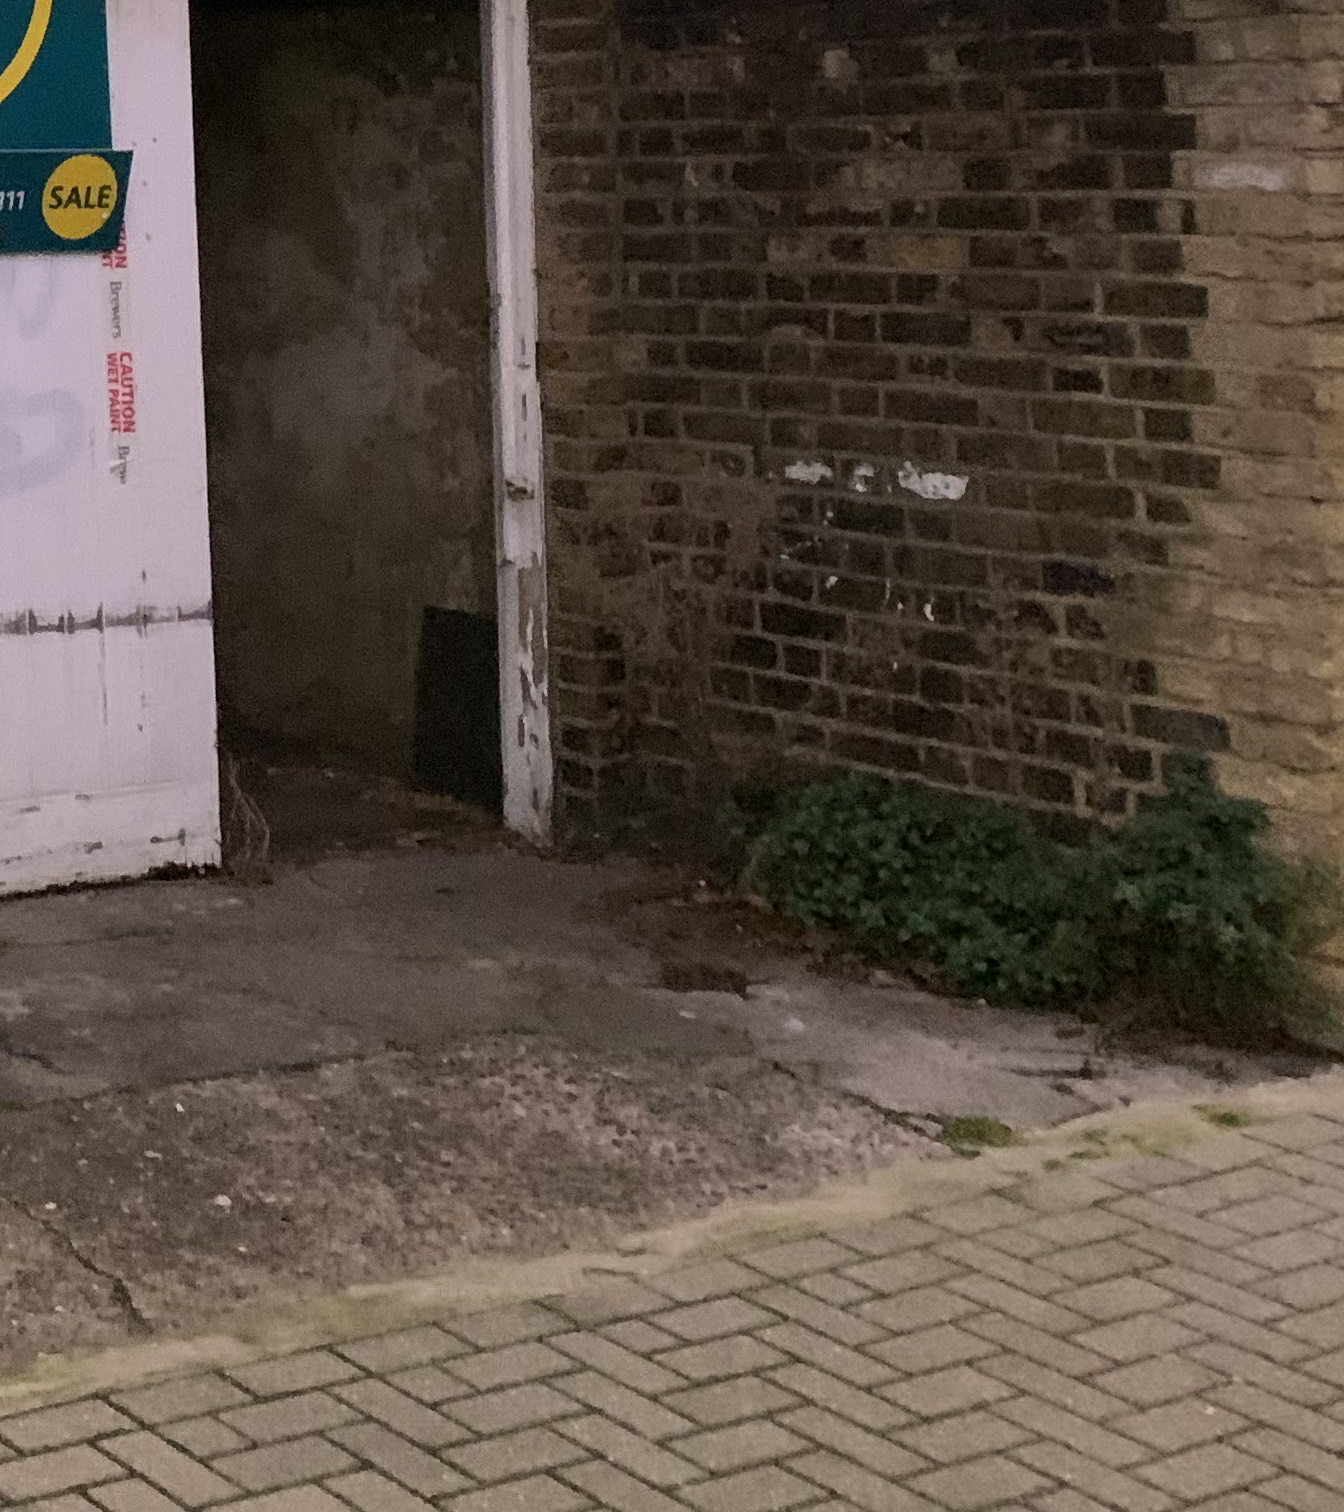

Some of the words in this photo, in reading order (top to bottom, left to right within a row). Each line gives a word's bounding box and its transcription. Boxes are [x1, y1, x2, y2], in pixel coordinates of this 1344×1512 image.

[48, 184, 113, 210] SALE
[110, 281, 122, 339] Brewers
[107, 352, 119, 384] WET
[108, 388, 121, 433] PAINT
[120, 352, 136, 433] CAUTION
